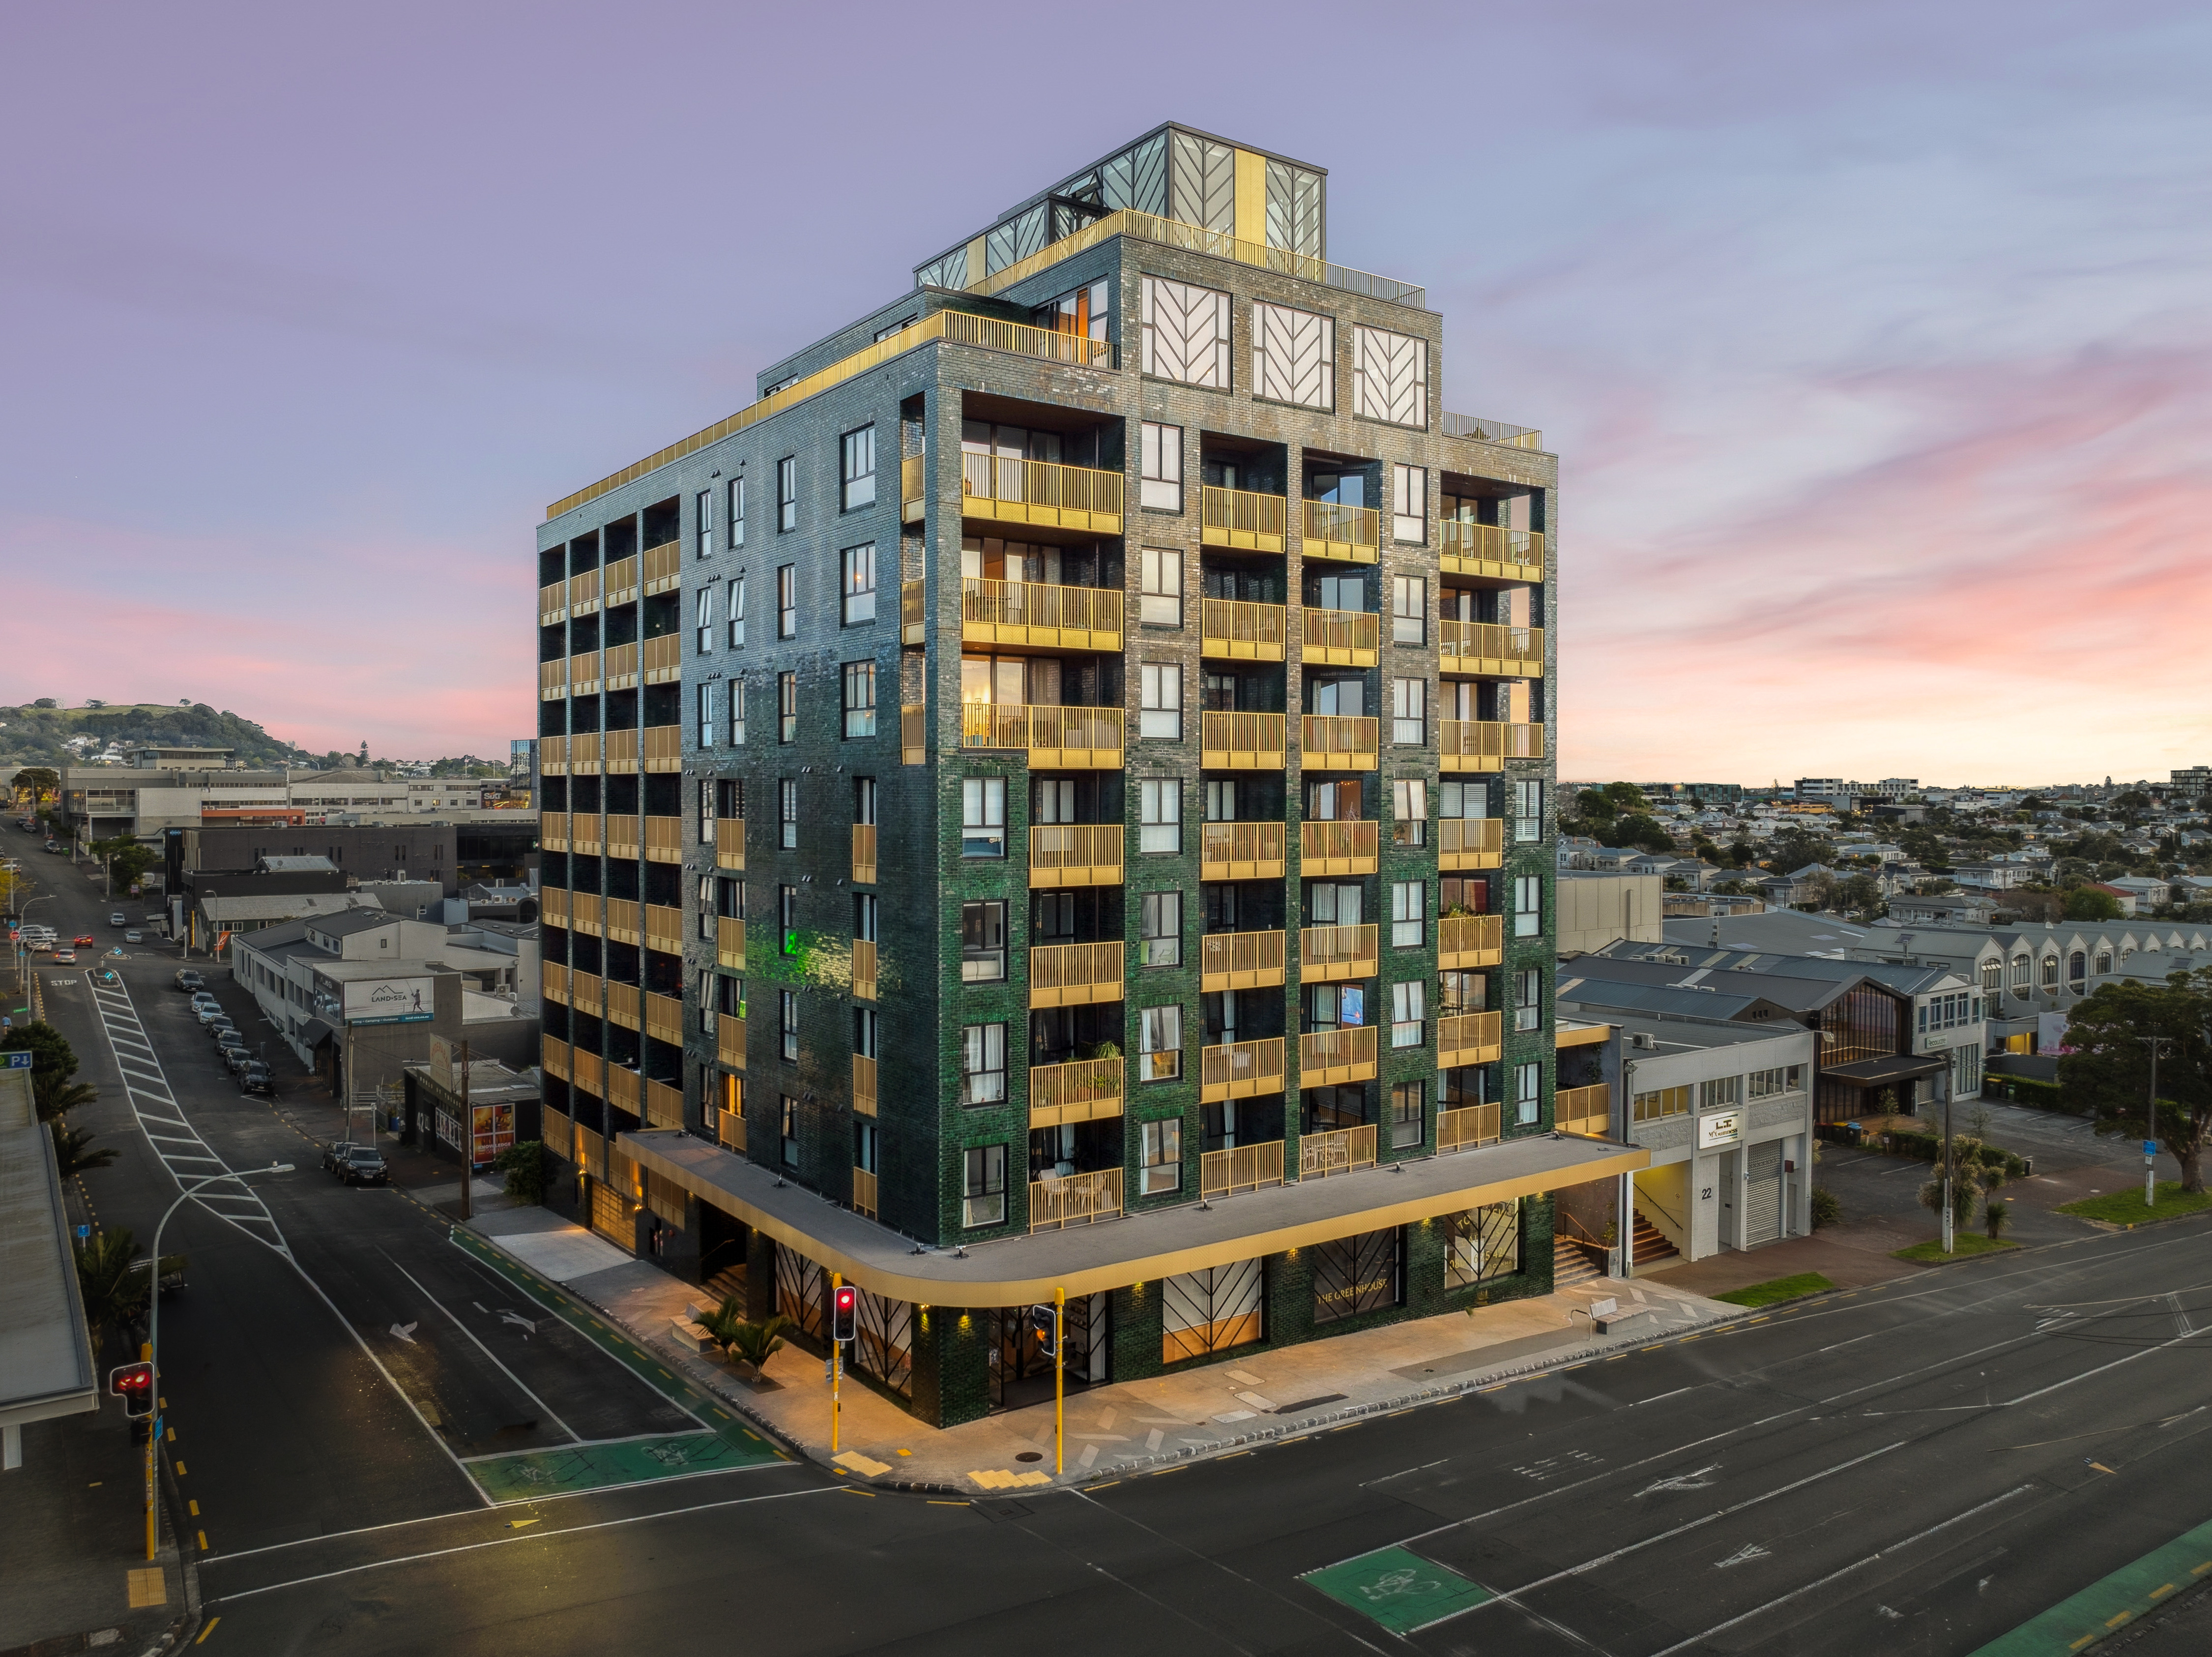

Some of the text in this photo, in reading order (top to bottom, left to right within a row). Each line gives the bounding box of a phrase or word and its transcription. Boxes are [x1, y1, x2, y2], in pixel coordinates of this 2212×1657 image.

[11, 1056, 20, 1066] P
[417, 1111, 424, 1133] 42
[1702, 1187, 1712, 1200] 22
[1317, 1279, 1387, 1304] THE GREENHOUSE
